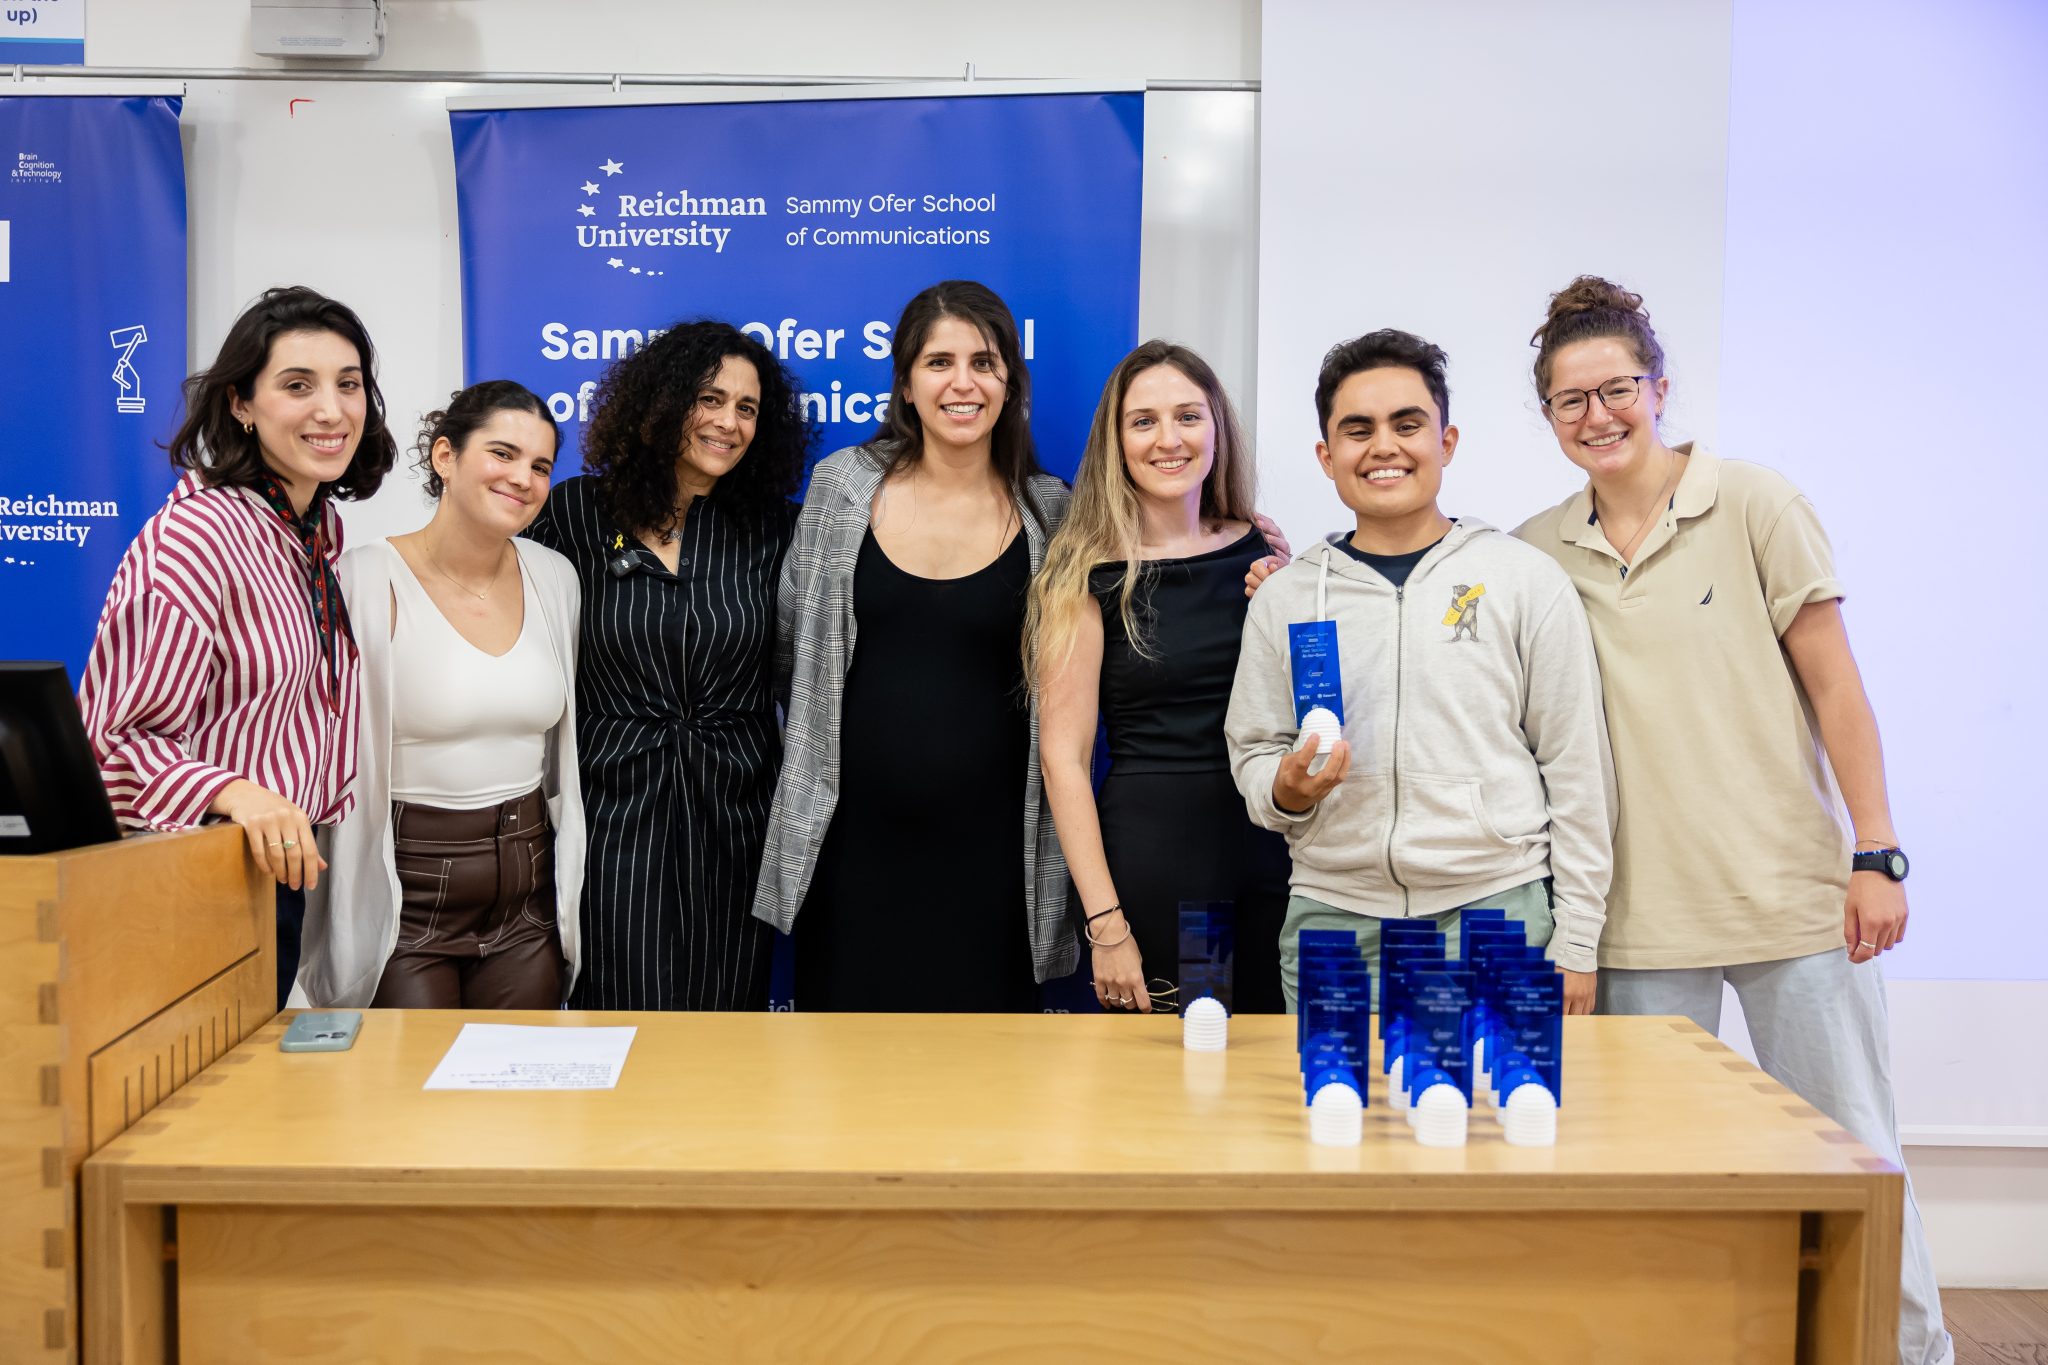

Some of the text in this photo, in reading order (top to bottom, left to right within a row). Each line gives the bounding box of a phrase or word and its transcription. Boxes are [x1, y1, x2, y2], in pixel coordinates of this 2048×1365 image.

[7, 7, 38, 26] up)
[19, 152, 38, 161] Brain
[19, 161, 55, 170] Cognition
[19, 169, 62, 178] Technology
[618, 189, 767, 217] Reichman
[786, 193, 995, 219] Sammy Ofer School
[576, 220, 731, 253] University
[786, 226, 990, 247] of Communications
[541, 321, 668, 360] Sam
[546, 380, 597, 423] of
[0, 494, 119, 517] Reichman
